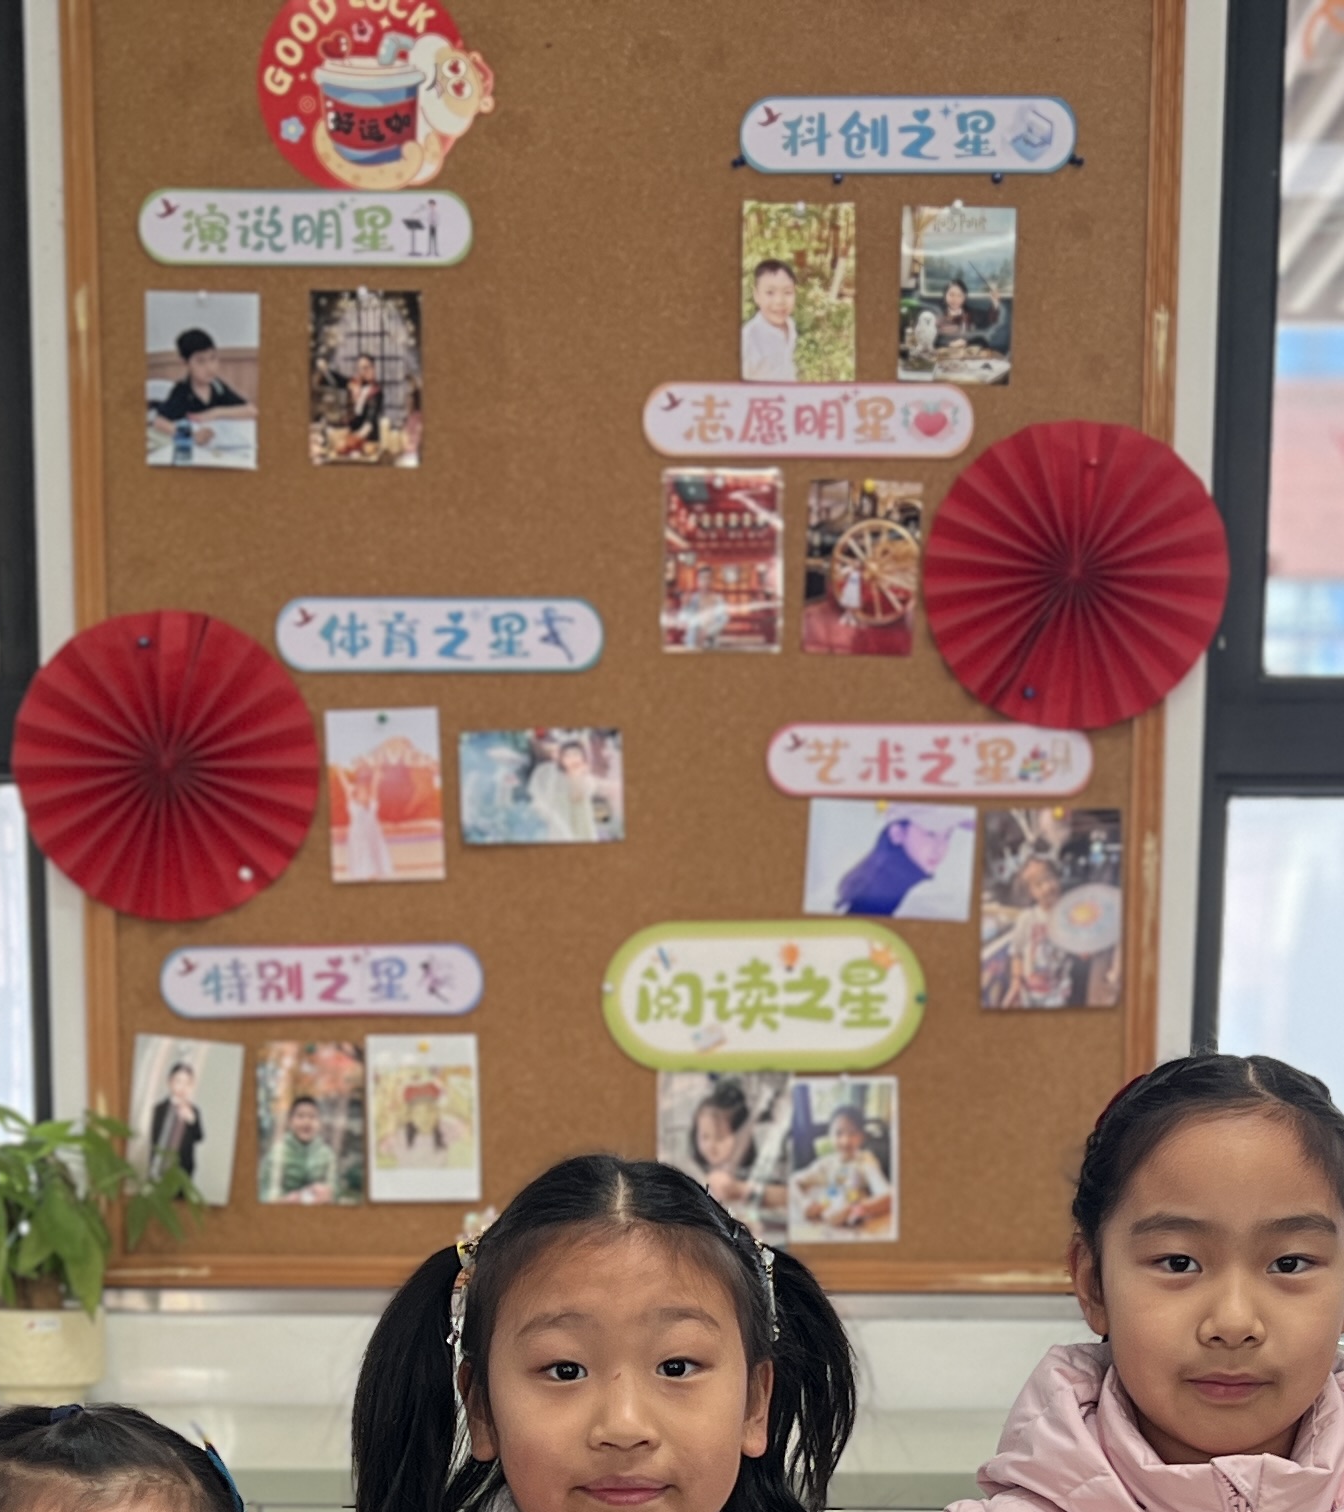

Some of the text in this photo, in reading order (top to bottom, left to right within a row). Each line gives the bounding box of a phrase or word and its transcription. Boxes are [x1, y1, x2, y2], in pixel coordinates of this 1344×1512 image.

[264, 0, 337, 95] GOOD
[781, 108, 997, 160] 科创之星
[182, 203, 395, 253] 演说明星
[683, 394, 897, 445] 志愿明星
[319, 611, 531, 660] 体育之星
[804, 736, 1019, 787] 艺术之星
[202, 956, 411, 1005] 特别之星
[634, 957, 892, 1032] 阅读之星
